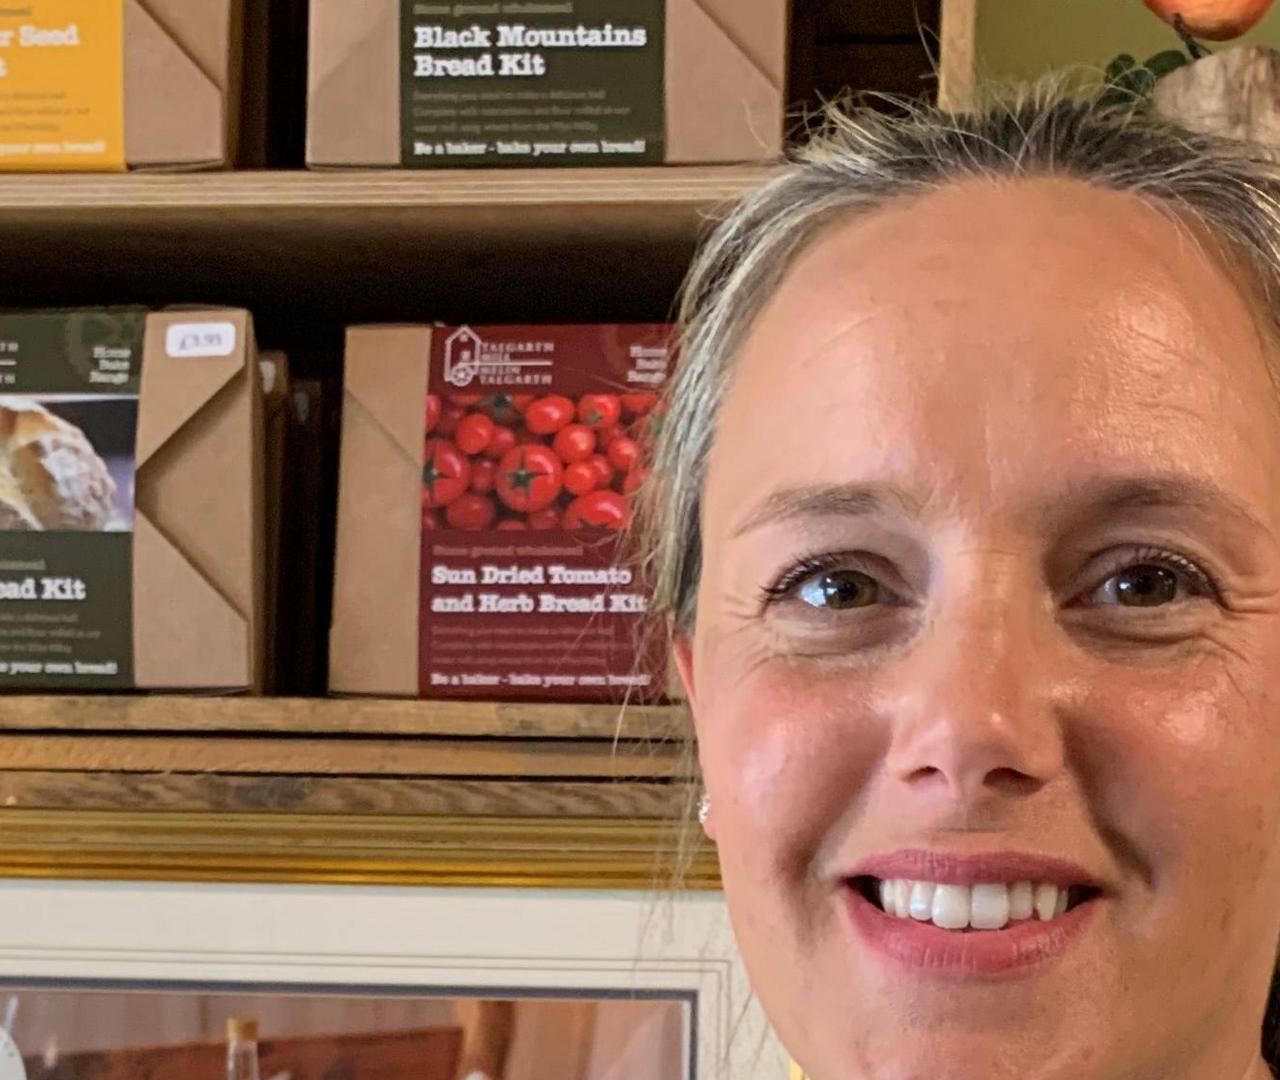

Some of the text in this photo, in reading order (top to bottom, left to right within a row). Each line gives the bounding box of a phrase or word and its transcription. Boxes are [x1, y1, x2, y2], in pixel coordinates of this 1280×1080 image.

[19, 23, 80, 46] Seed
[414, 23, 647, 47] Black Mountains
[414, 53, 546, 76] Bread Kit
[431, 564, 632, 584] Sun Dried Tomato
[41, 578, 86, 600] Kit
[431, 594, 474, 612] and
[478, 594, 534, 612] Herb
[538, 593, 605, 612] Bread
